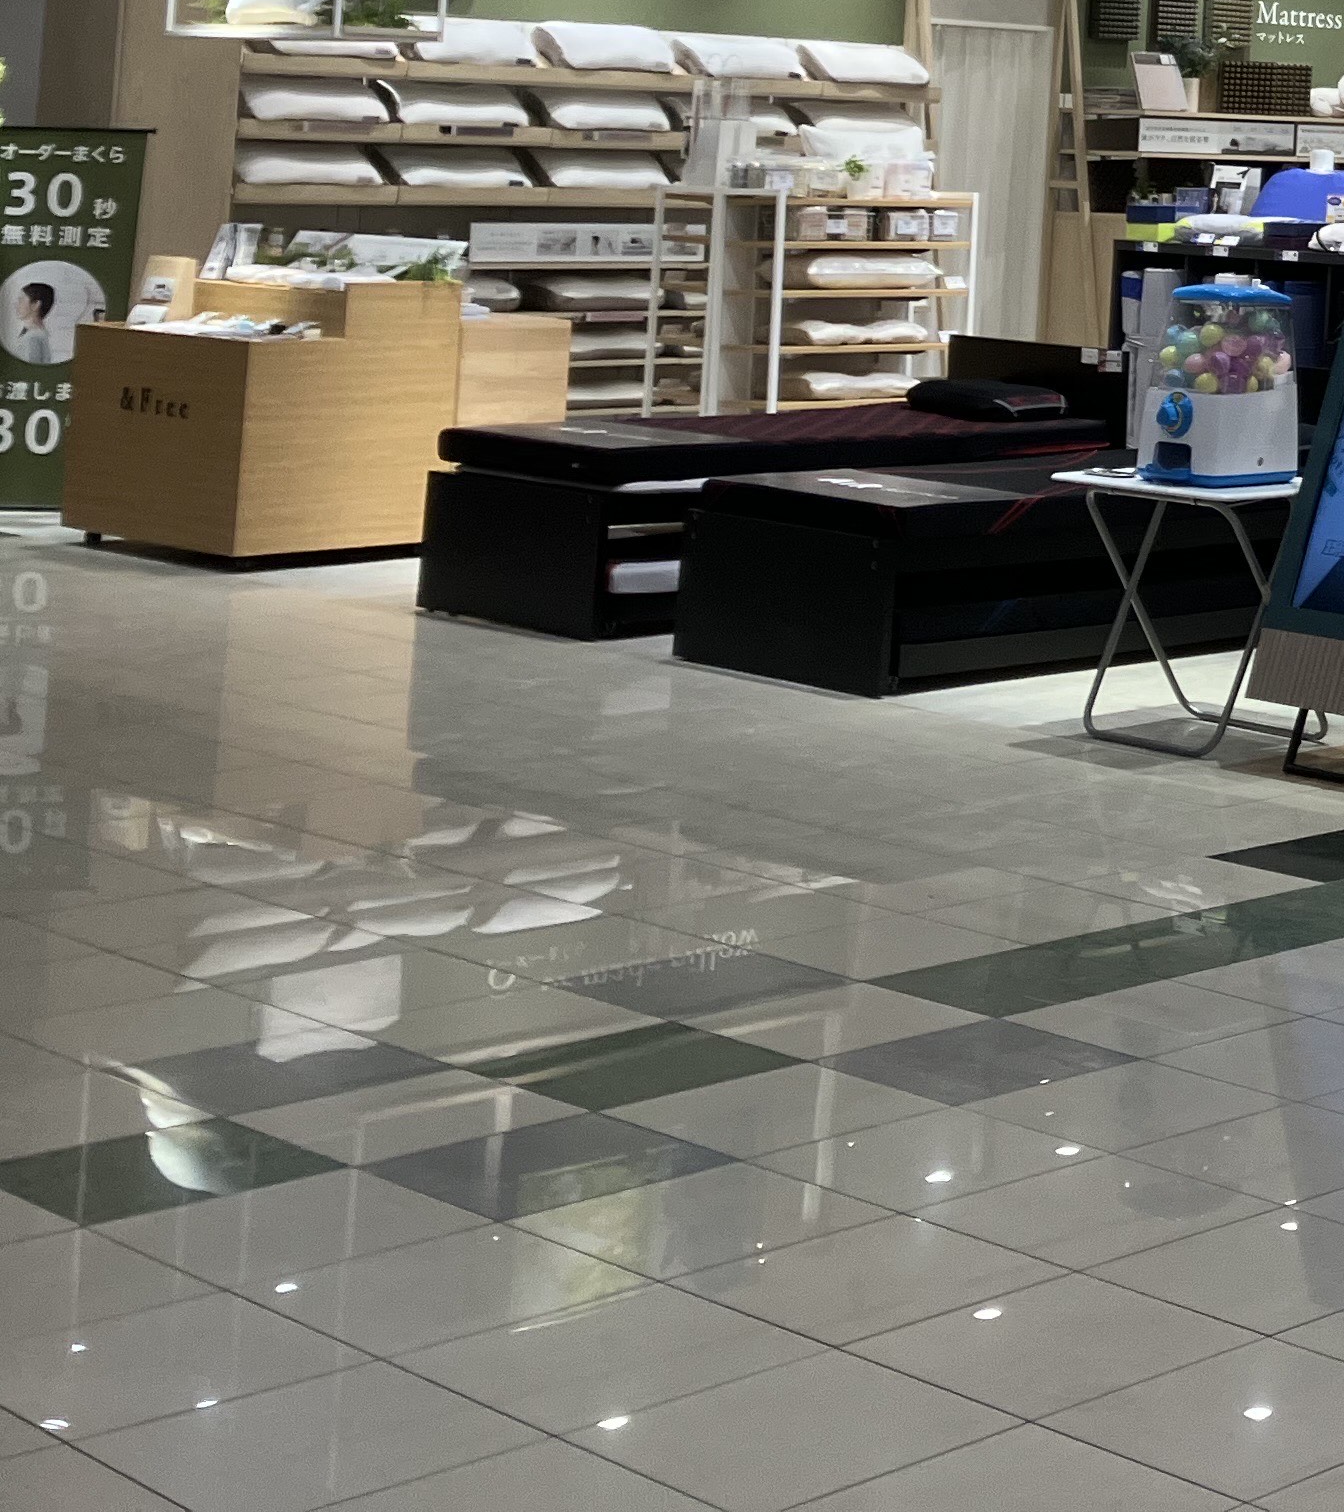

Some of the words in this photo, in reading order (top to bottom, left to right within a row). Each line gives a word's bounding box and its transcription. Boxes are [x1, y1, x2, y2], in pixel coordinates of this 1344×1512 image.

[1256, 0, 1343, 30] Mattress
[1256, 31, 1305, 45] マットレス
[0, 143, 126, 164] オーダーまくら
[0, 224, 112, 248] 無料測定
[120, 386, 190, 420] &Free
